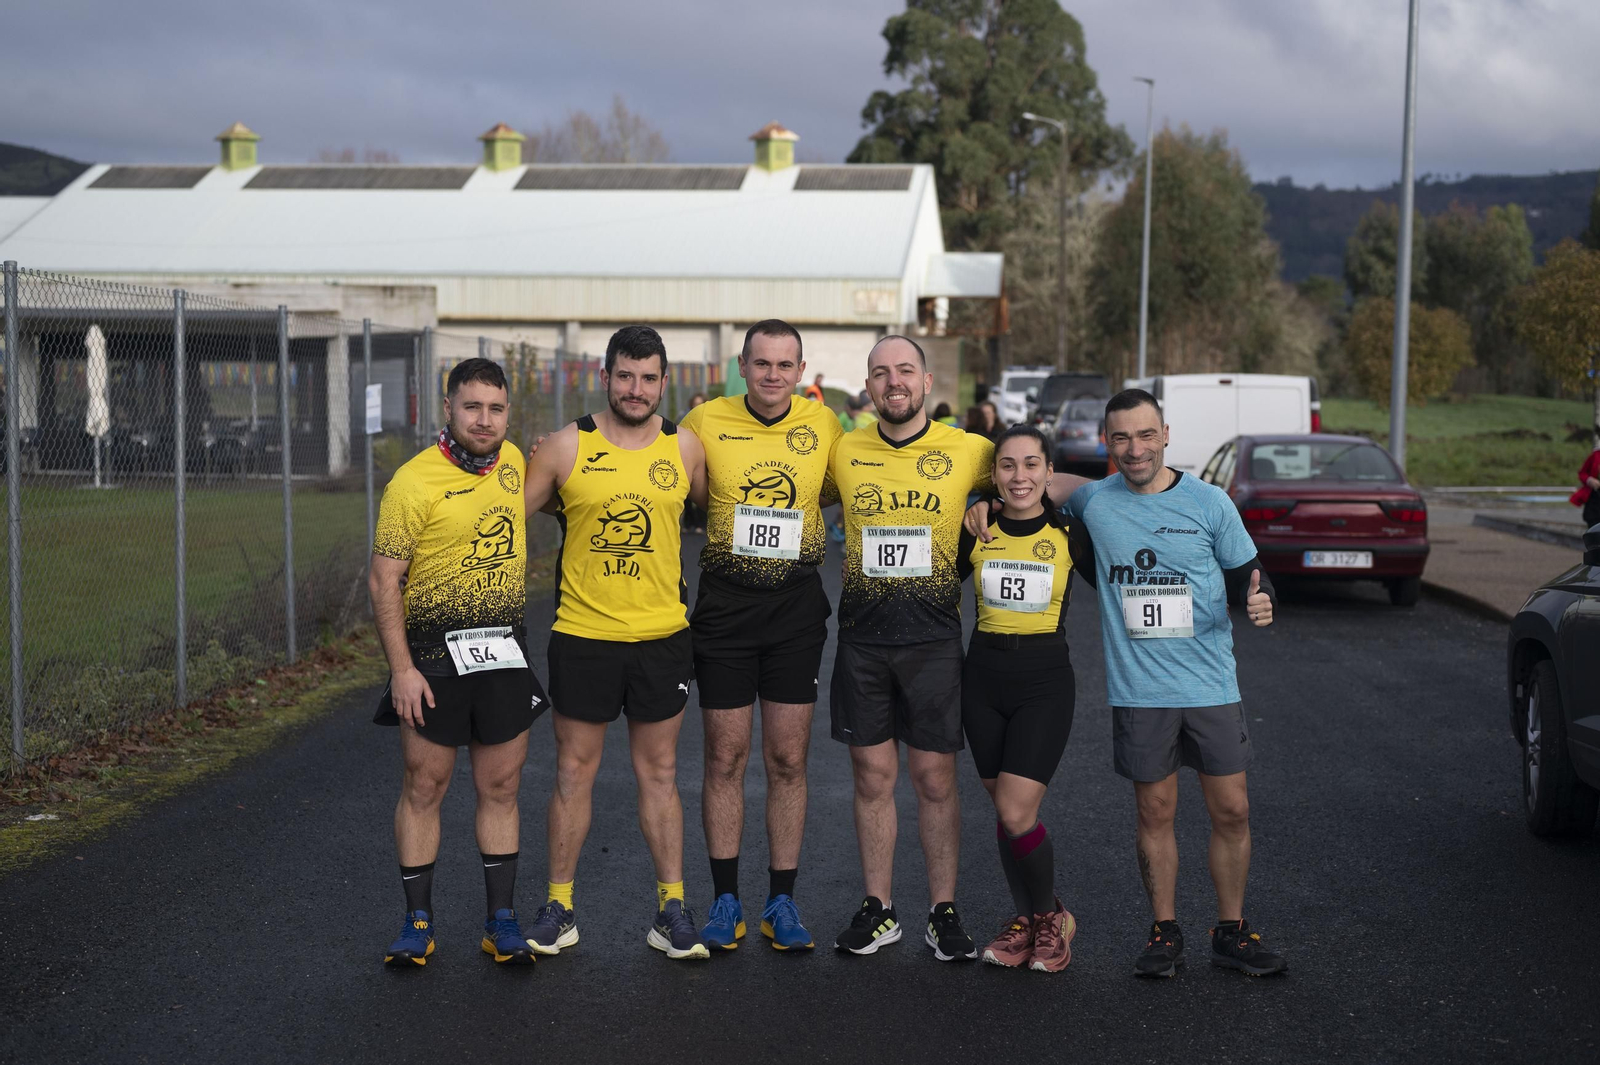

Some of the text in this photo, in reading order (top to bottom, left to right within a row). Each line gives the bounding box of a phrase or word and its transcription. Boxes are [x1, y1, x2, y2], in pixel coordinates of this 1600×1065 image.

[743, 461, 798, 478] GANADERÍA
[602, 492, 655, 513] GANADERÍA
[889, 490, 941, 514] J.P.D.
[473, 506, 517, 530] GANADERÍA
[740, 507, 752, 516] XXV
[752, 508, 771, 517] CROSS
[748, 523, 781, 548] 188
[867, 528, 878, 536] XXV
[879, 528, 897, 537] CROSS
[1167, 527, 1199, 535] Babolat
[877, 544, 908, 567] 187
[1332, 553, 1358, 565] 3127
[1364, 553, 1371, 565] T
[602, 558, 641, 580] J.P.D.
[988, 561, 1000, 569] XXV
[1001, 561, 1020, 570] CROSS
[1135, 569, 1188, 578] deportesmatch
[475, 570, 508, 593] J.P.D.
[1000, 576, 1026, 601] 63
[1136, 576, 1188, 585] PADEL
[1126, 588, 1138, 597] XXV
[1138, 588, 1157, 597] CROSS
[1143, 603, 1162, 627] 91
[464, 630, 484, 640] CROSS
[468, 646, 498, 664] 64
